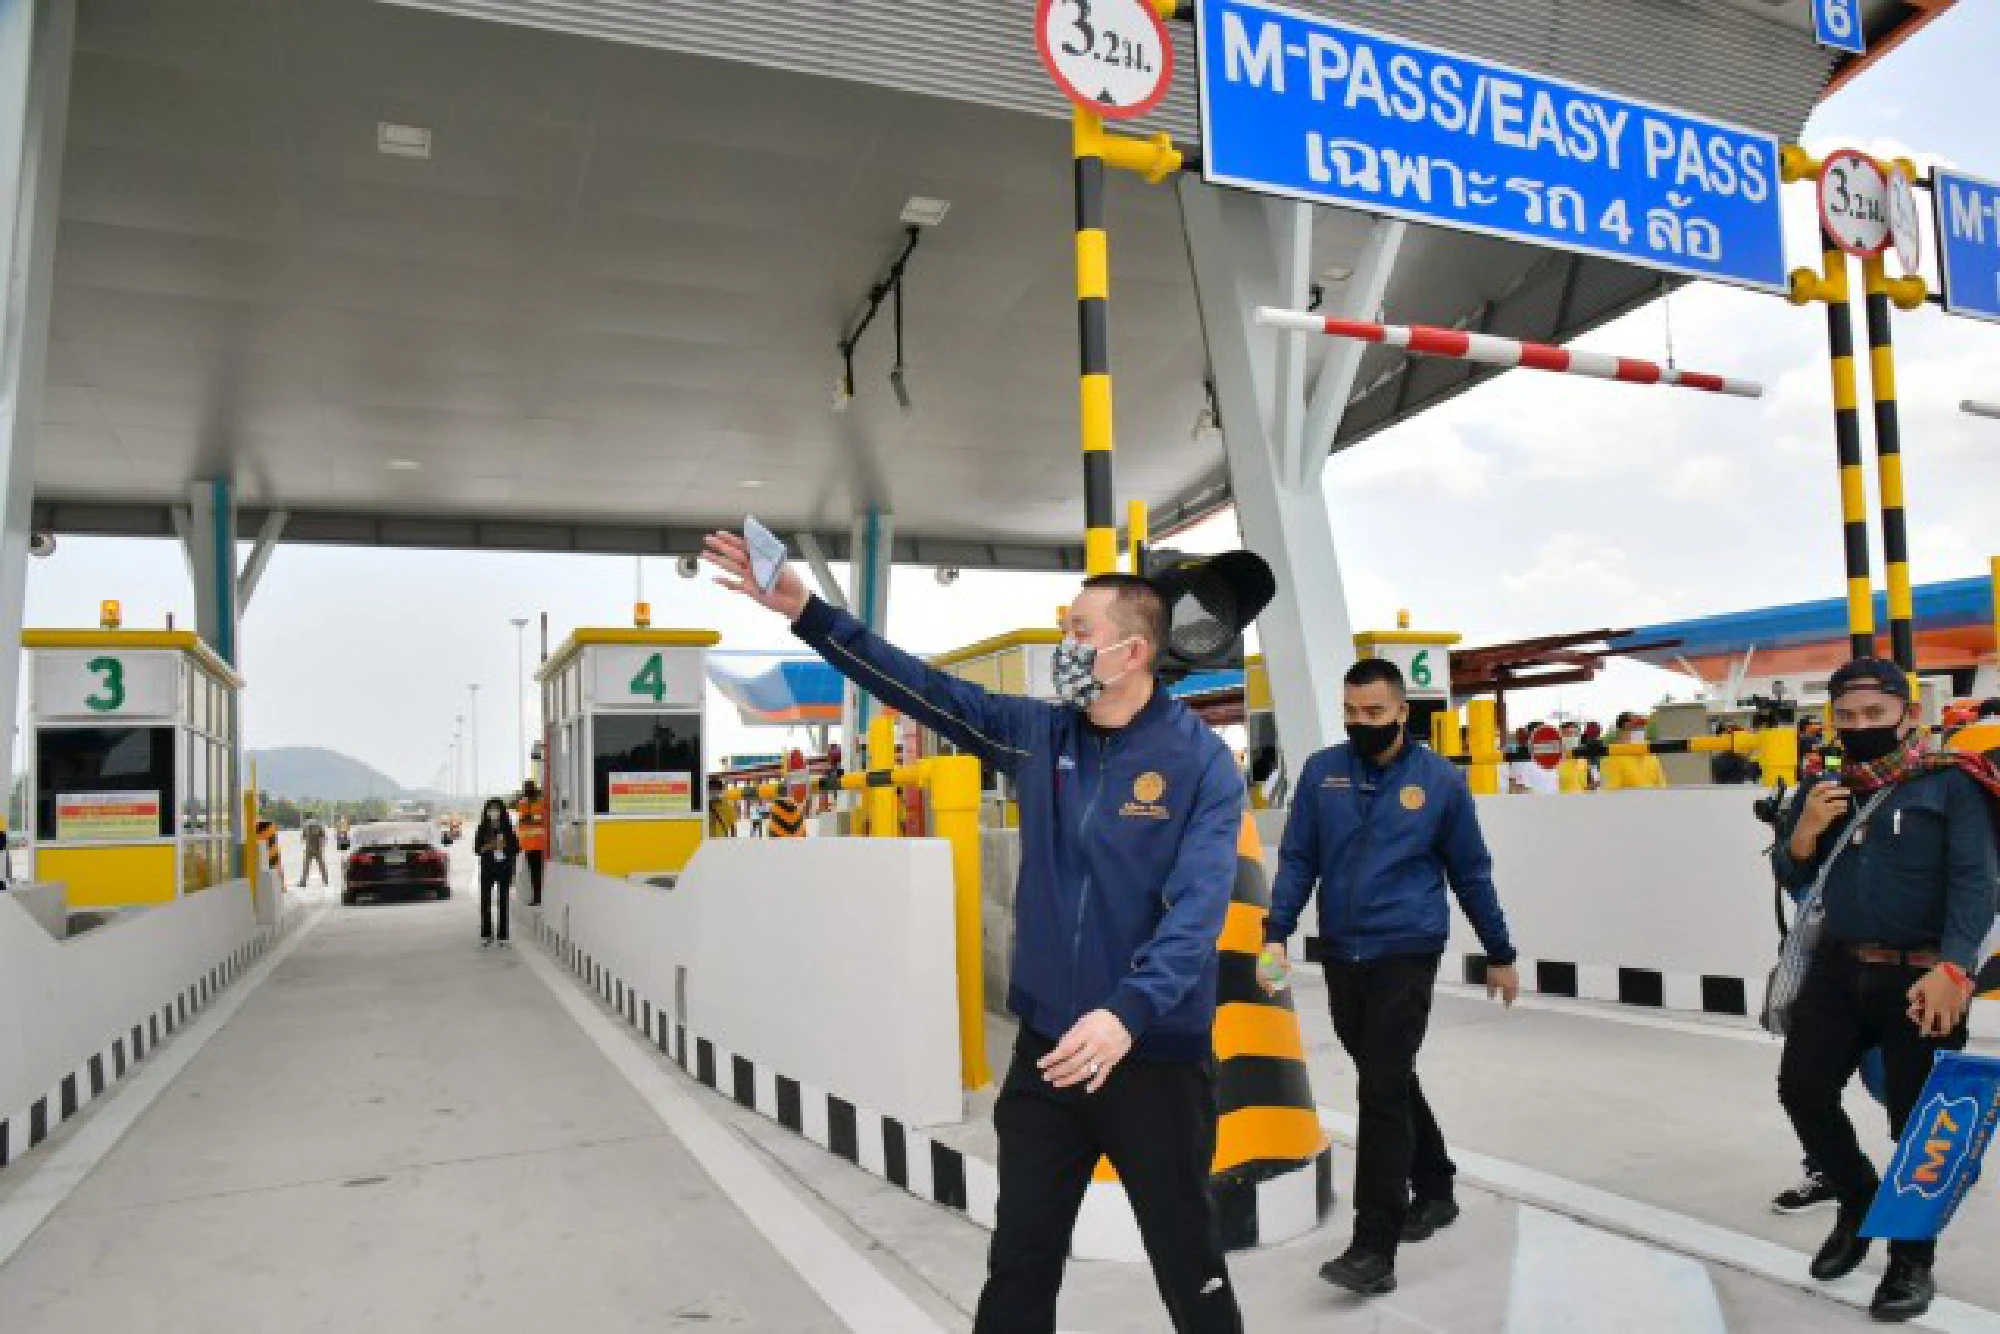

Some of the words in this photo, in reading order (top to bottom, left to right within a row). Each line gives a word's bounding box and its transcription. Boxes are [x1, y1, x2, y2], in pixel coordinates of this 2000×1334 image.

[1825, 0, 1850, 37] 6
[1221, 10, 1628, 170] M-PASS/EASY
[1643, 117, 1768, 203] PASS
[1305, 130, 1498, 209] เฉพาะ
[1505, 176, 1586, 235] รถ
[1600, 198, 1634, 245] 4
[1646, 190, 1722, 262] ล้อ
[84, 655, 125, 712] 3
[629, 652, 666, 704] 4
[1410, 650, 1432, 688] 6
[1912, 1107, 1960, 1183] M7
